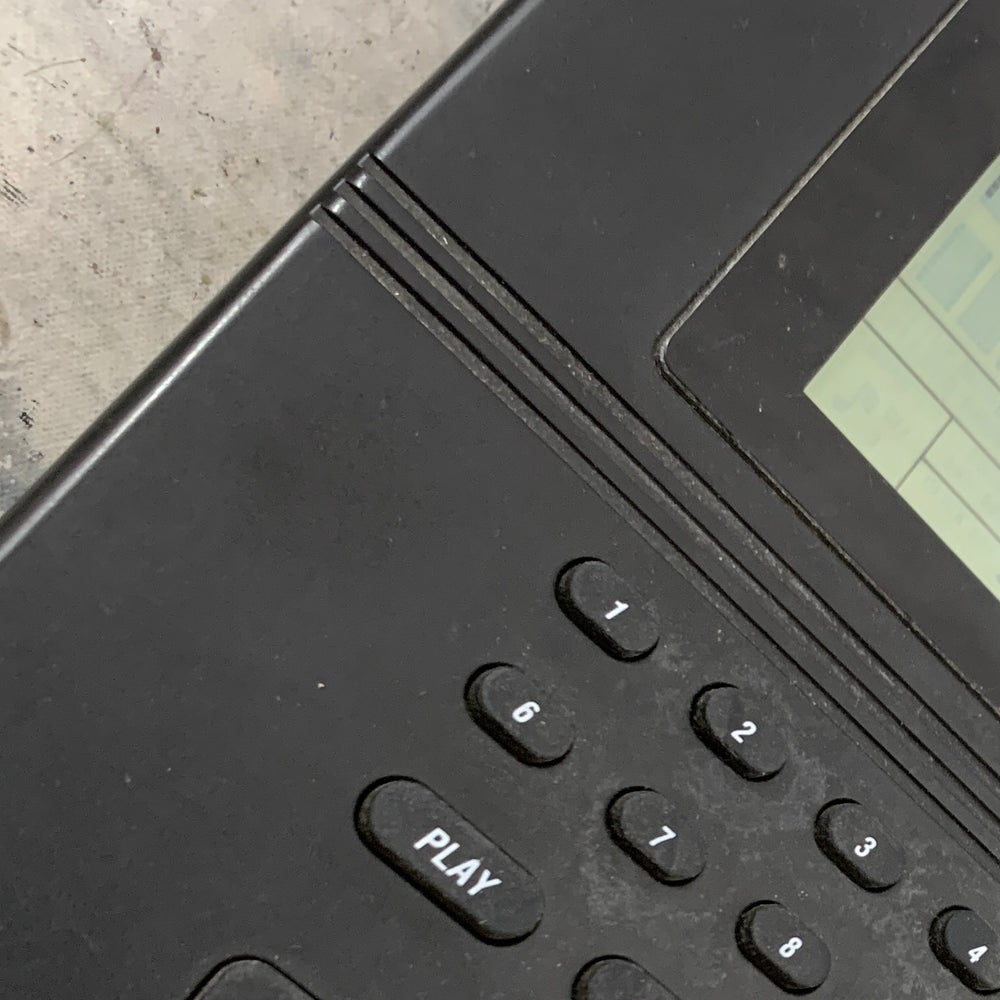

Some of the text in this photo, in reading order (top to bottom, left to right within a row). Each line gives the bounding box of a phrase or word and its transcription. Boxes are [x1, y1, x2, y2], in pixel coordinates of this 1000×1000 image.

[604, 600, 629, 620] 1
[512, 701, 541, 723] 6
[730, 720, 757, 744] 2
[648, 825, 677, 847] 7
[854, 836, 877, 858] 3
[413, 827, 502, 896] PLAY
[778, 937, 803, 958] 8
[968, 945, 988, 964] 4
